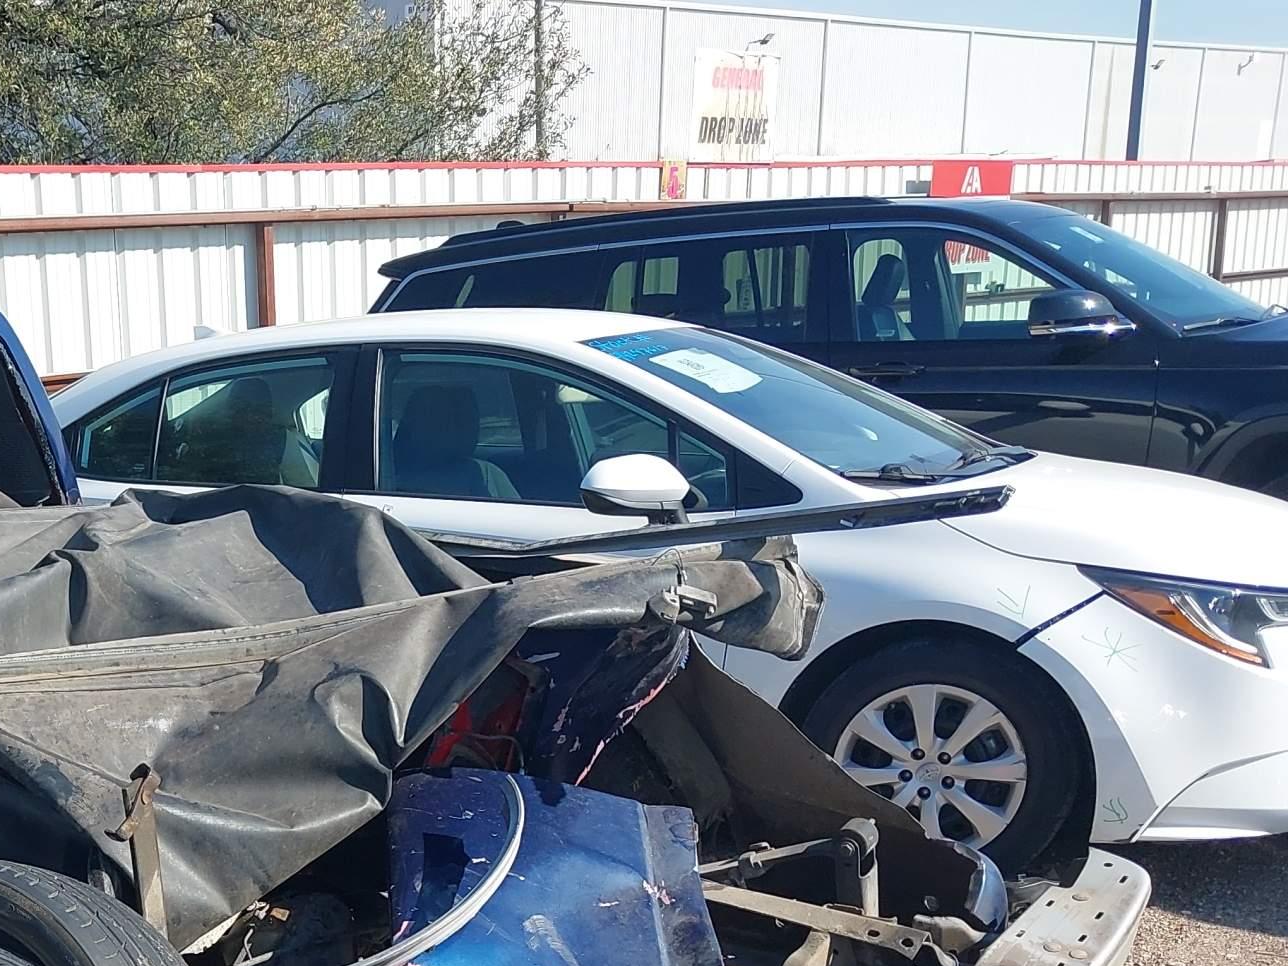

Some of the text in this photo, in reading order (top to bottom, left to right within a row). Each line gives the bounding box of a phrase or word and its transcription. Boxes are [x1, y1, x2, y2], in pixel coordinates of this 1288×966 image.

[697, 116, 768, 144] DROP ZONE
[945, 241, 966, 265] ROP
